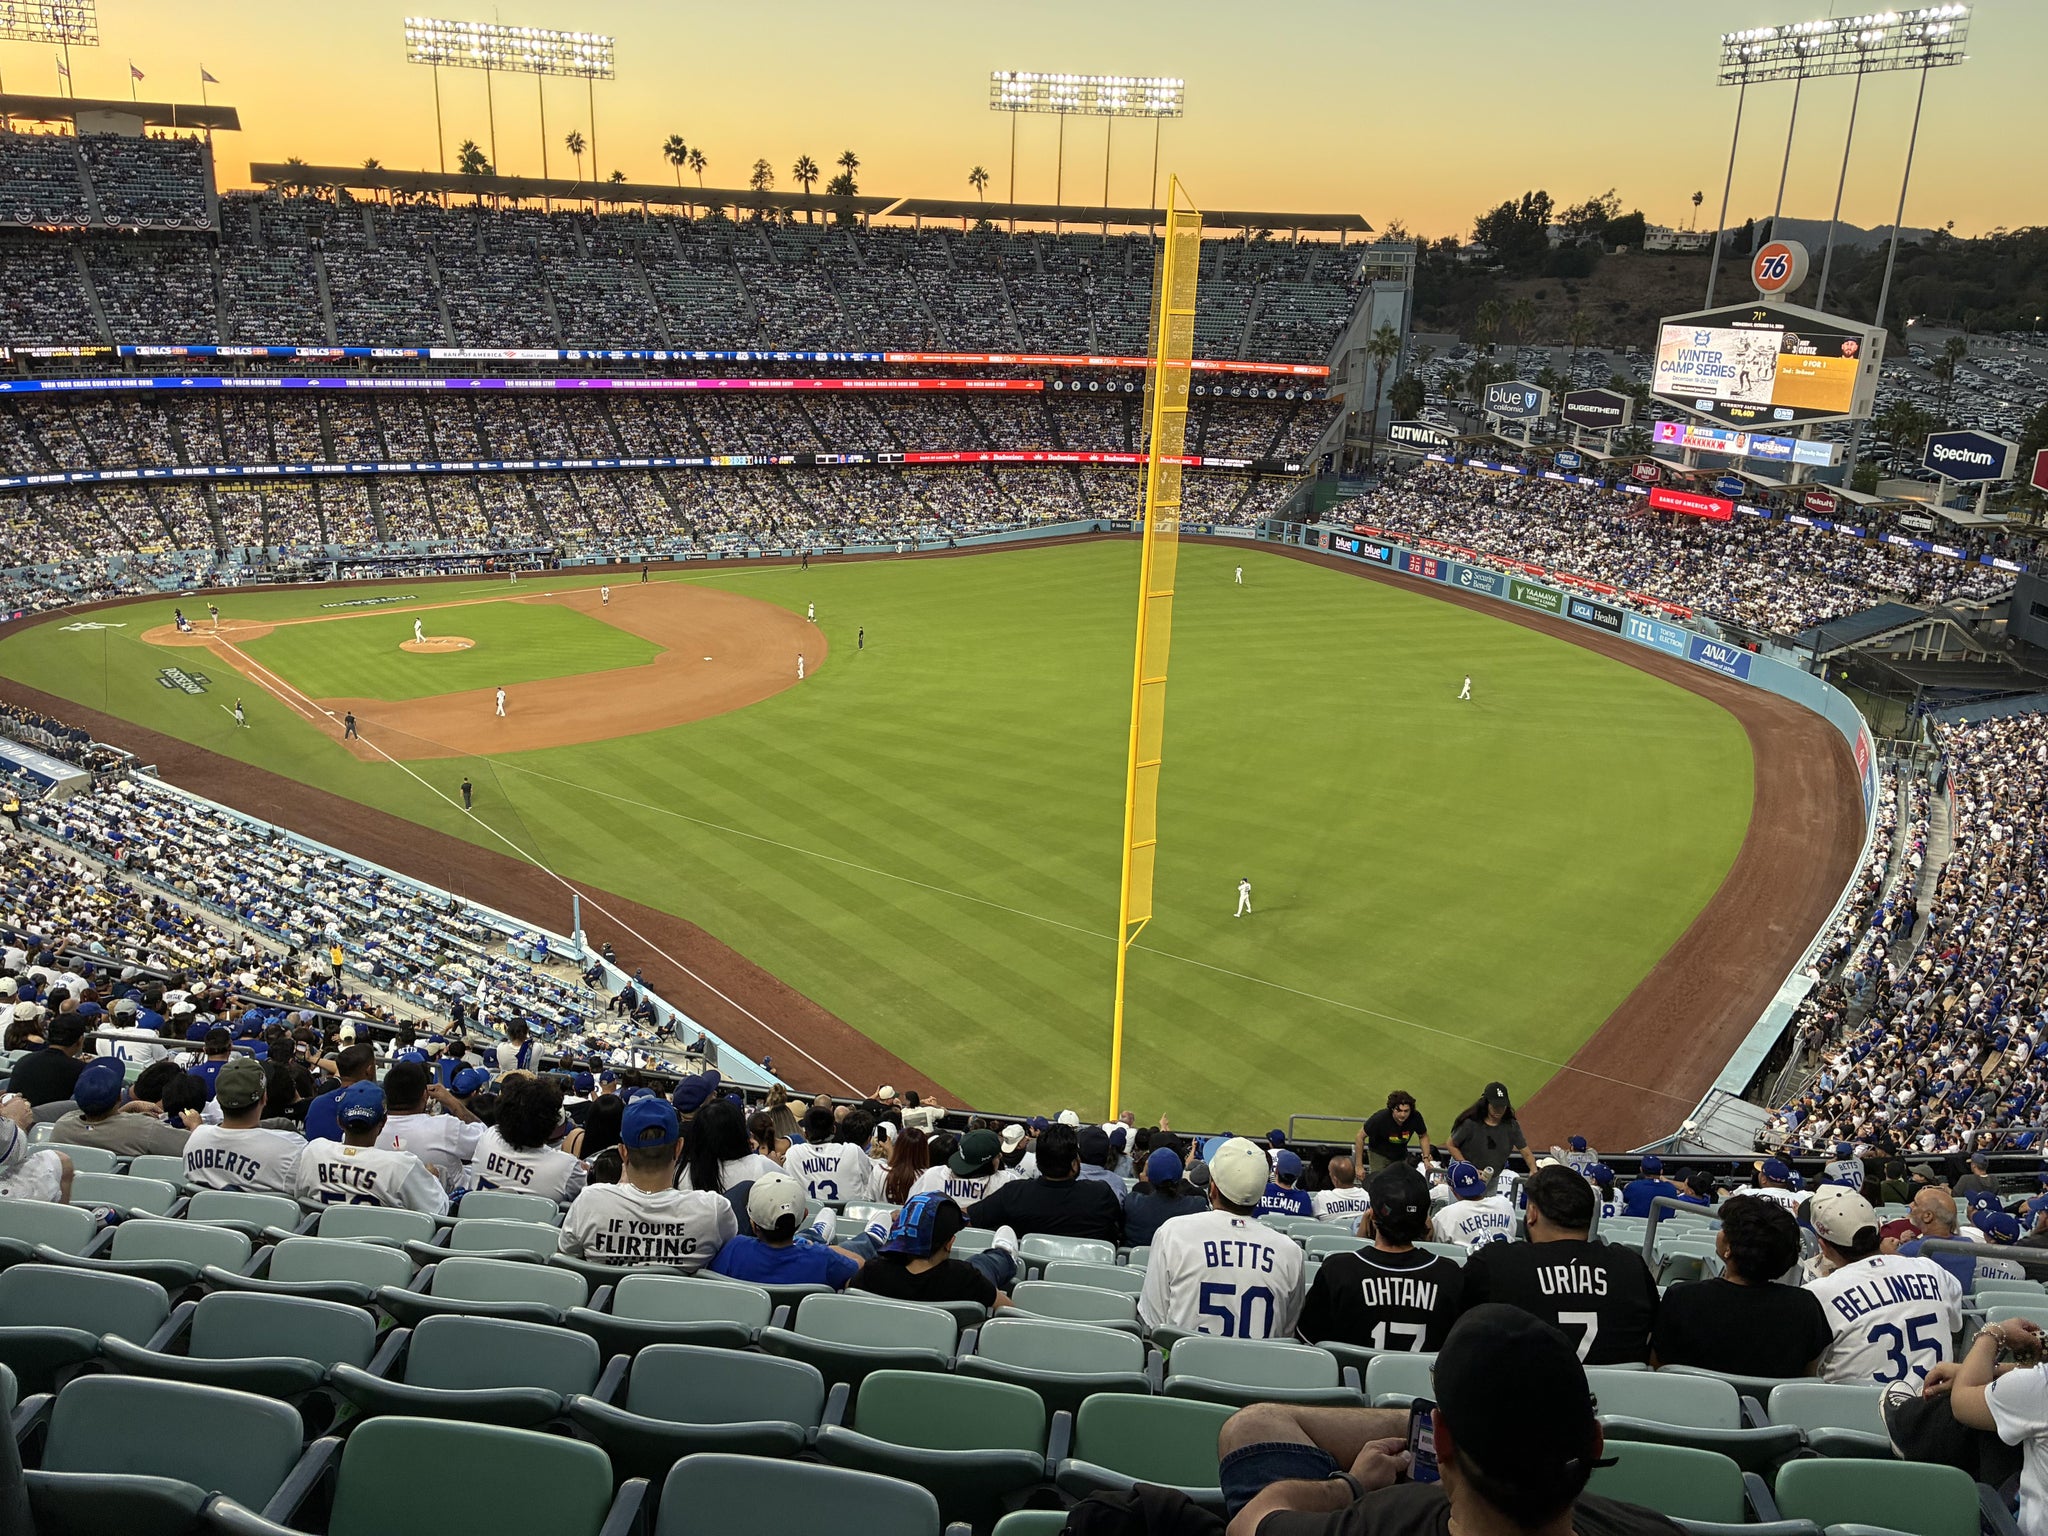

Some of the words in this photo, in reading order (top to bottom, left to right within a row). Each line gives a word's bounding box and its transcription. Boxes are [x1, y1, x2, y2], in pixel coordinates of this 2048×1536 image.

[1759, 254, 1789, 280] 76
[1678, 349, 1722, 363] WINTER
[1799, 347, 1817, 355] ORTIZ
[1661, 360, 1694, 374] CAMP
[1696, 364, 1736, 378] SERIES
[1489, 387, 1521, 404] blue
[1493, 404, 1524, 413] california
[1567, 403, 1620, 415] GUGGENHEIM
[1932, 444, 1991, 466] Spectrum
[1637, 464, 1656, 476] JINRO
[1683, 500, 1708, 510] AMERICA
[1808, 497, 1833, 508] Yakult
[1336, 536, 1352, 548] blue
[1364, 543, 1380, 556] blue
[1473, 579, 1492, 592] Benefit
[1474, 572, 1495, 585] Security
[1574, 606, 1590, 616] UCLA
[1594, 610, 1618, 626] Health
[1630, 618, 1654, 642] TEL
[1660, 628, 1676, 638] TOKYO
[1660, 635, 1683, 648] ELECTRON
[1702, 644, 1728, 662] ANA
[188, 1148, 260, 1181] ROBERTS
[487, 1152, 534, 1185] BETTS
[802, 1157, 841, 1175] MUNCY
[1838, 1162, 1858, 1170] BETTS
[318, 1163, 377, 1190] BETTS
[808, 1180, 839, 1200] 13
[944, 1180, 986, 1199] MUNCY
[609, 1219, 623, 1233] IF
[629, 1221, 685, 1236] YOU'RE
[1460, 1214, 1510, 1235] KERSHAW
[596, 1233, 696, 1256] FLIRTING
[1204, 1240, 1274, 1273] BETTS
[1537, 1258, 1607, 1296] URÍAS
[1362, 1277, 1438, 1311] OHTANI
[1831, 1274, 1942, 1322] BELLINGER
[1198, 1282, 1274, 1339] 50
[1371, 1321, 1426, 1352] 17
[1558, 1312, 1598, 1364] 7
[1867, 1313, 1943, 1383] 35
